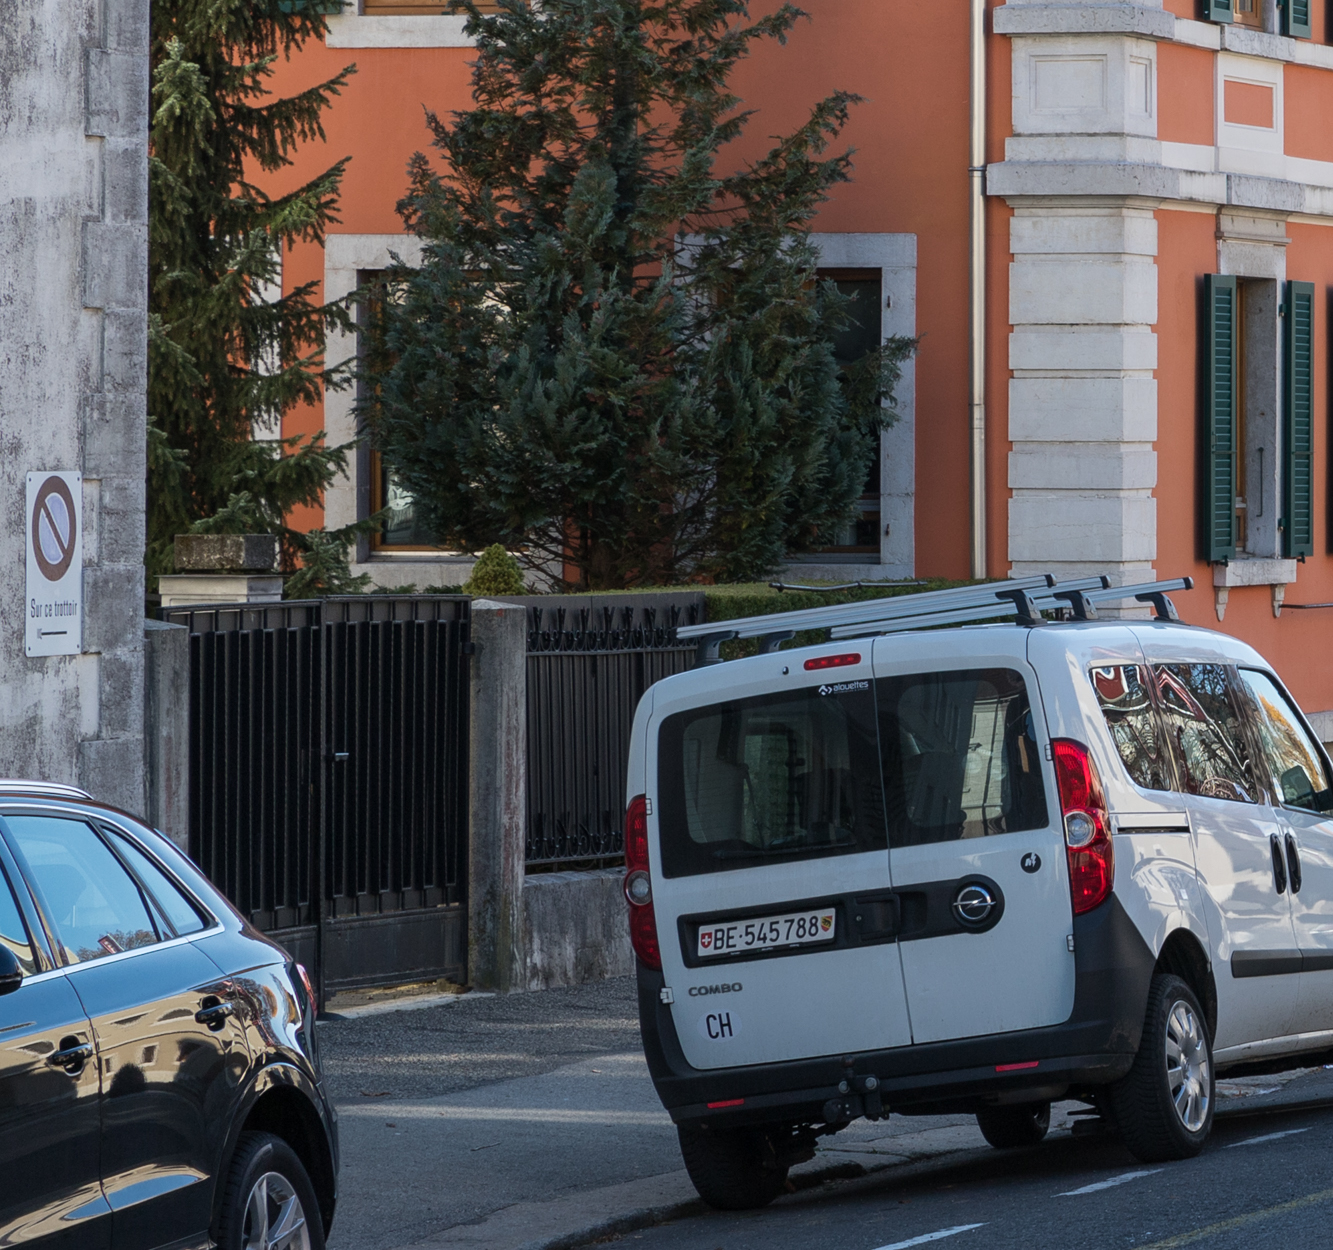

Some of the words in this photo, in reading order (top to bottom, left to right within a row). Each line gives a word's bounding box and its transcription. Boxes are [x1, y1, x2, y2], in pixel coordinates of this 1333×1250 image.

[31, 598, 42, 618] Sur
[45, 604, 52, 618] ce
[54, 600, 77, 617] trottoir
[833, 681, 869, 692] alouettes
[688, 982, 743, 998] COMBO
[706, 1012, 733, 1039] CH
